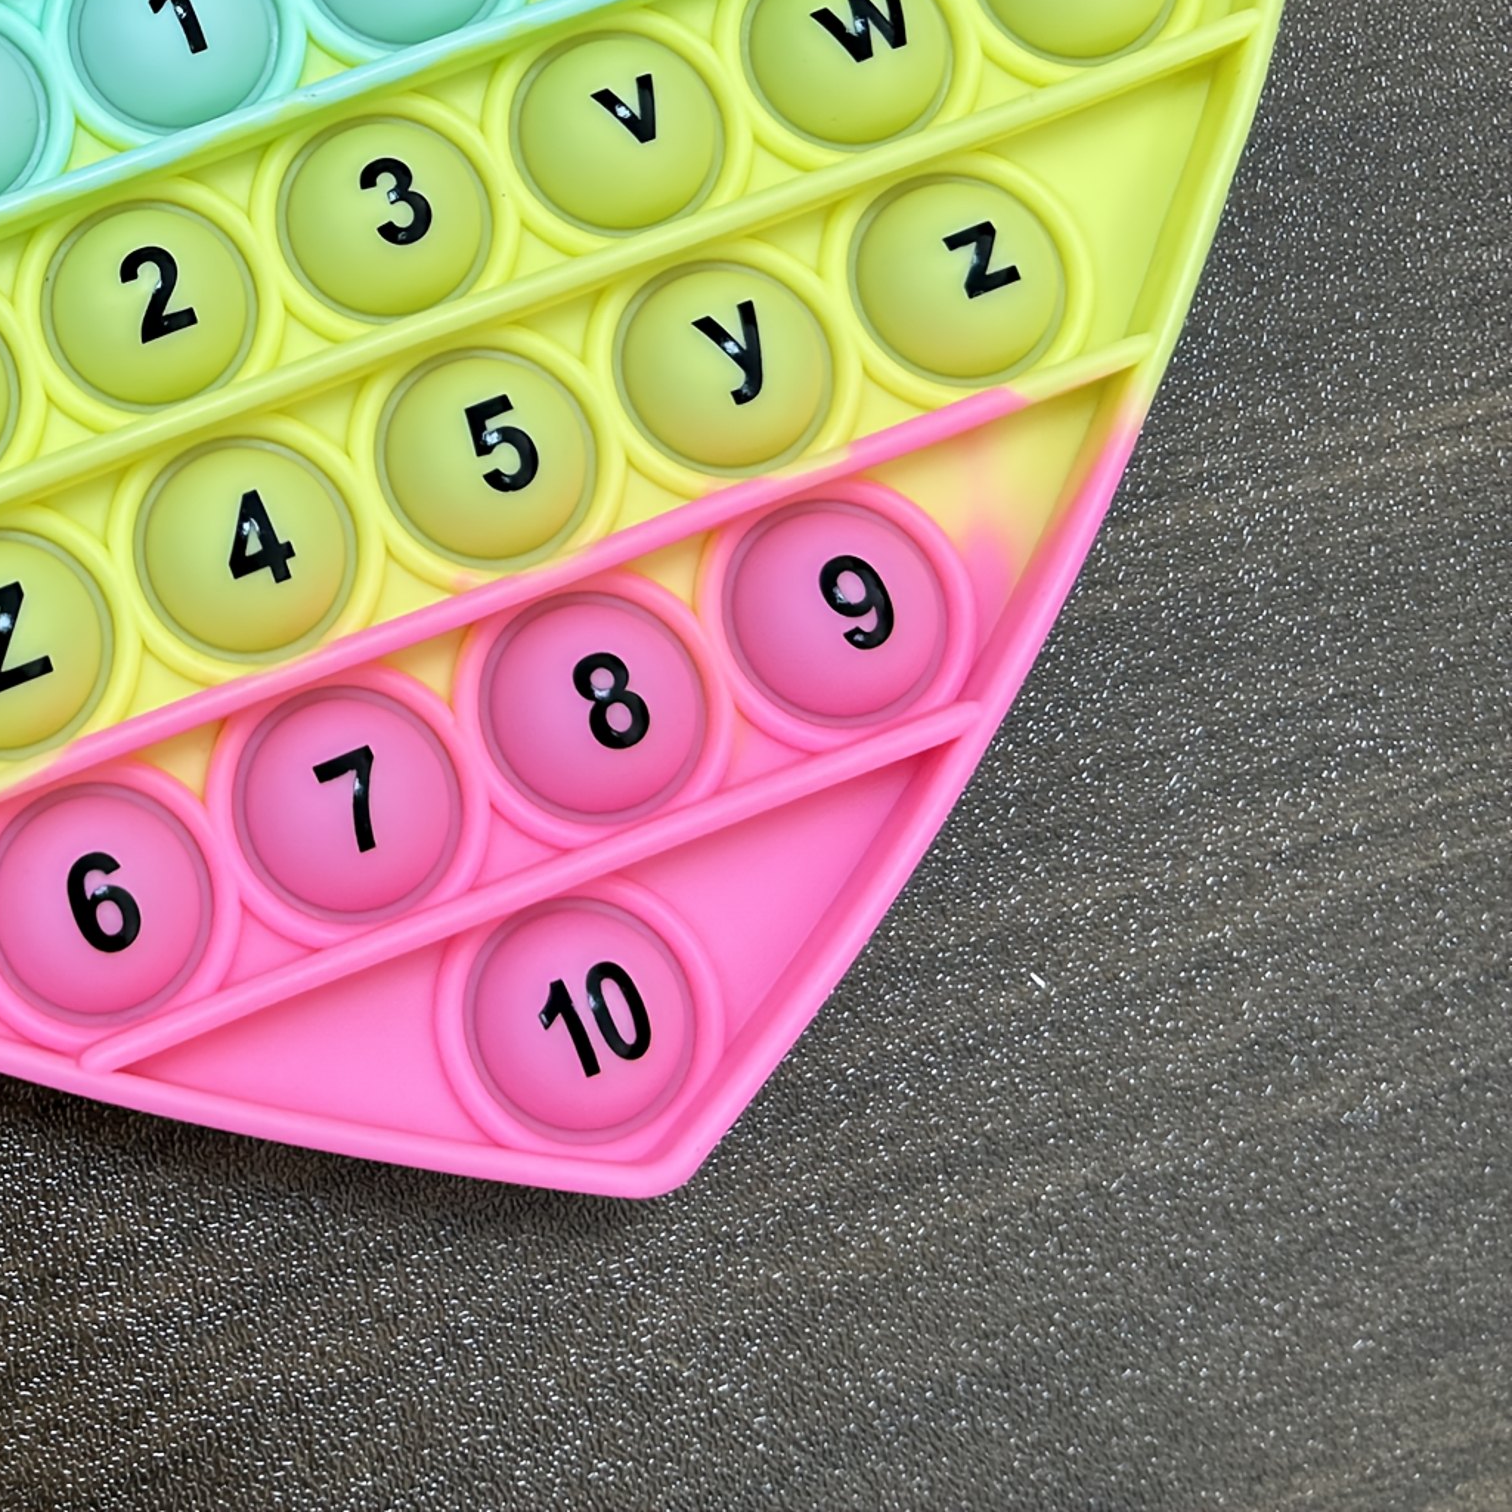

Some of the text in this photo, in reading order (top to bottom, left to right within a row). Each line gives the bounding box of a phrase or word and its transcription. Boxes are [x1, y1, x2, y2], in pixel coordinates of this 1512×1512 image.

[119, 246, 198, 345] 2
[359, 157, 433, 246] 3
[590, 73, 657, 144] v
[228, 489, 296, 584] 4
[464, 394, 539, 493] 5
[691, 300, 763, 406] y
[942, 220, 1021, 299] z
[67, 555, 895, 953] 6 7 8 9
[538, 961, 652, 1078] 10
